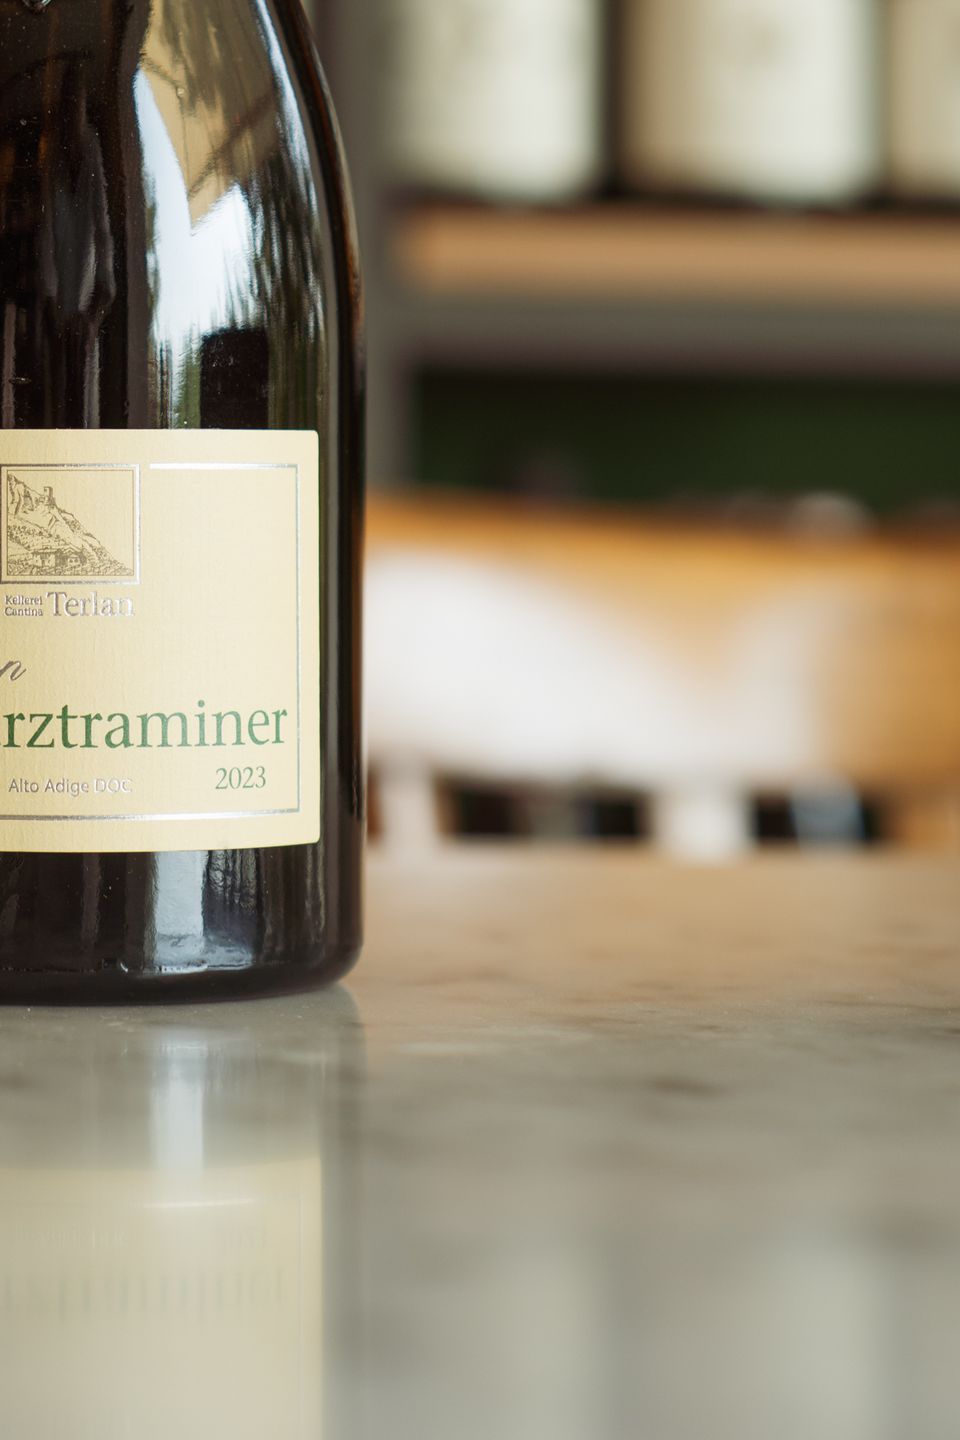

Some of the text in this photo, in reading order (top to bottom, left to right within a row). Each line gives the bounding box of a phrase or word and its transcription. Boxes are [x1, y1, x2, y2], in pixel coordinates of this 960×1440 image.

[5, 594, 43, 605] Kellerei
[46, 591, 135, 617] Terlan
[4, 606, 44, 616] Cantina
[8, 777, 134, 797] Alto Adige DOC
[214, 766, 267, 791] 2023
